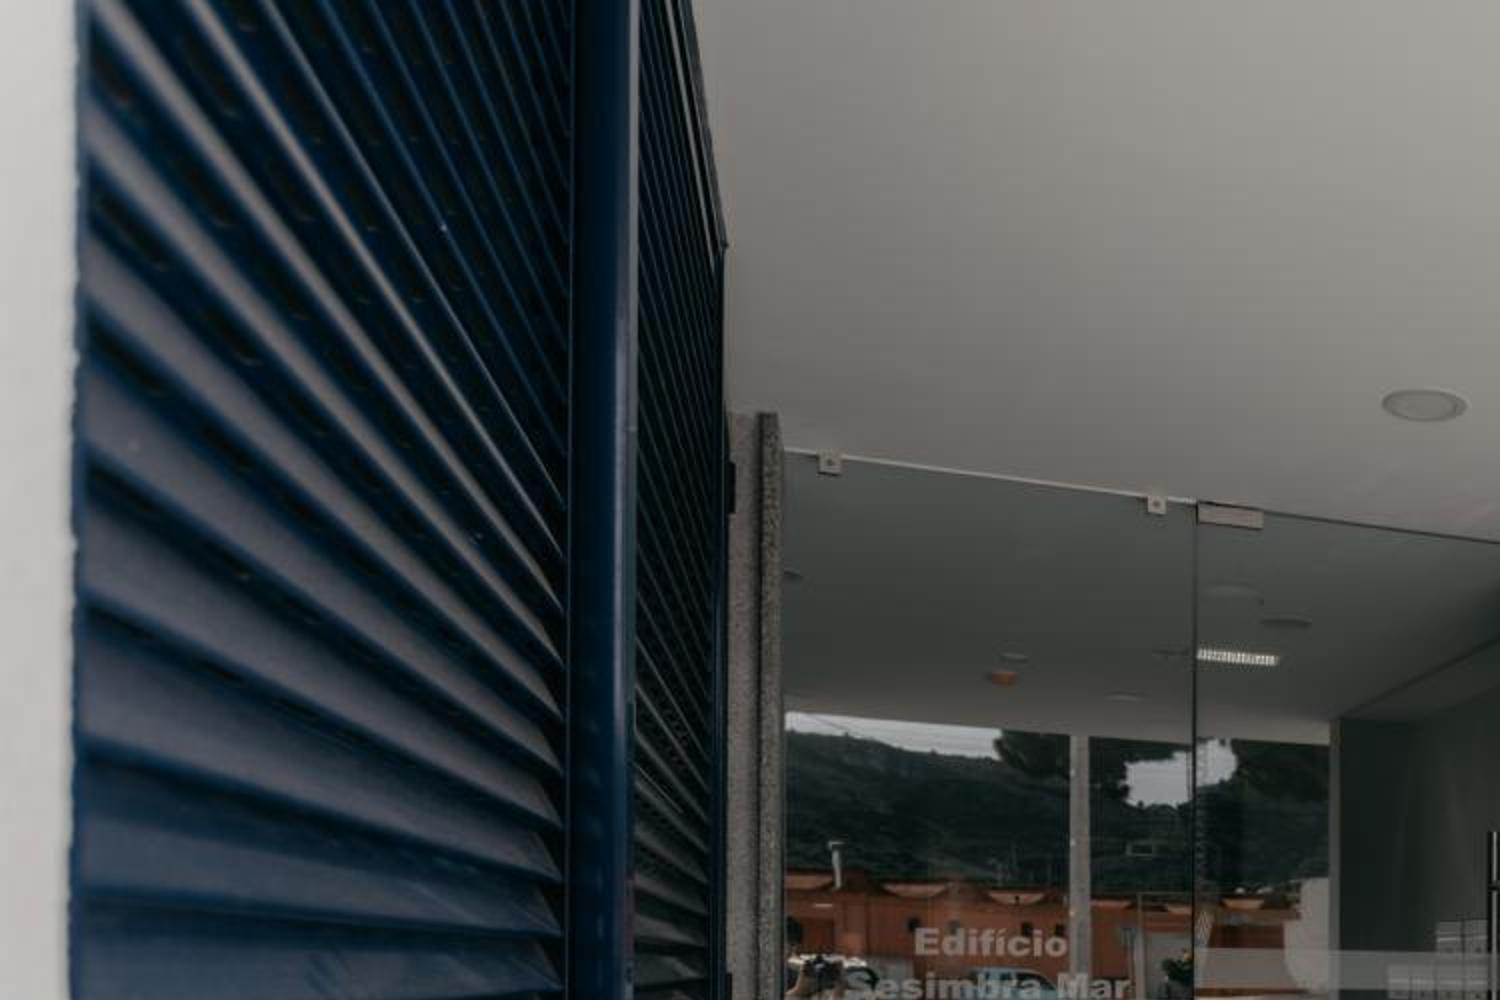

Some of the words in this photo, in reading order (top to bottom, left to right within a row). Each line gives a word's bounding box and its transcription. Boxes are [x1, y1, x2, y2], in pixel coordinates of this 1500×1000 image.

[914, 927, 1069, 957] Edifício
[846, 971, 1042, 1000] Sesimbra
[1056, 971, 1132, 1000] Mar
